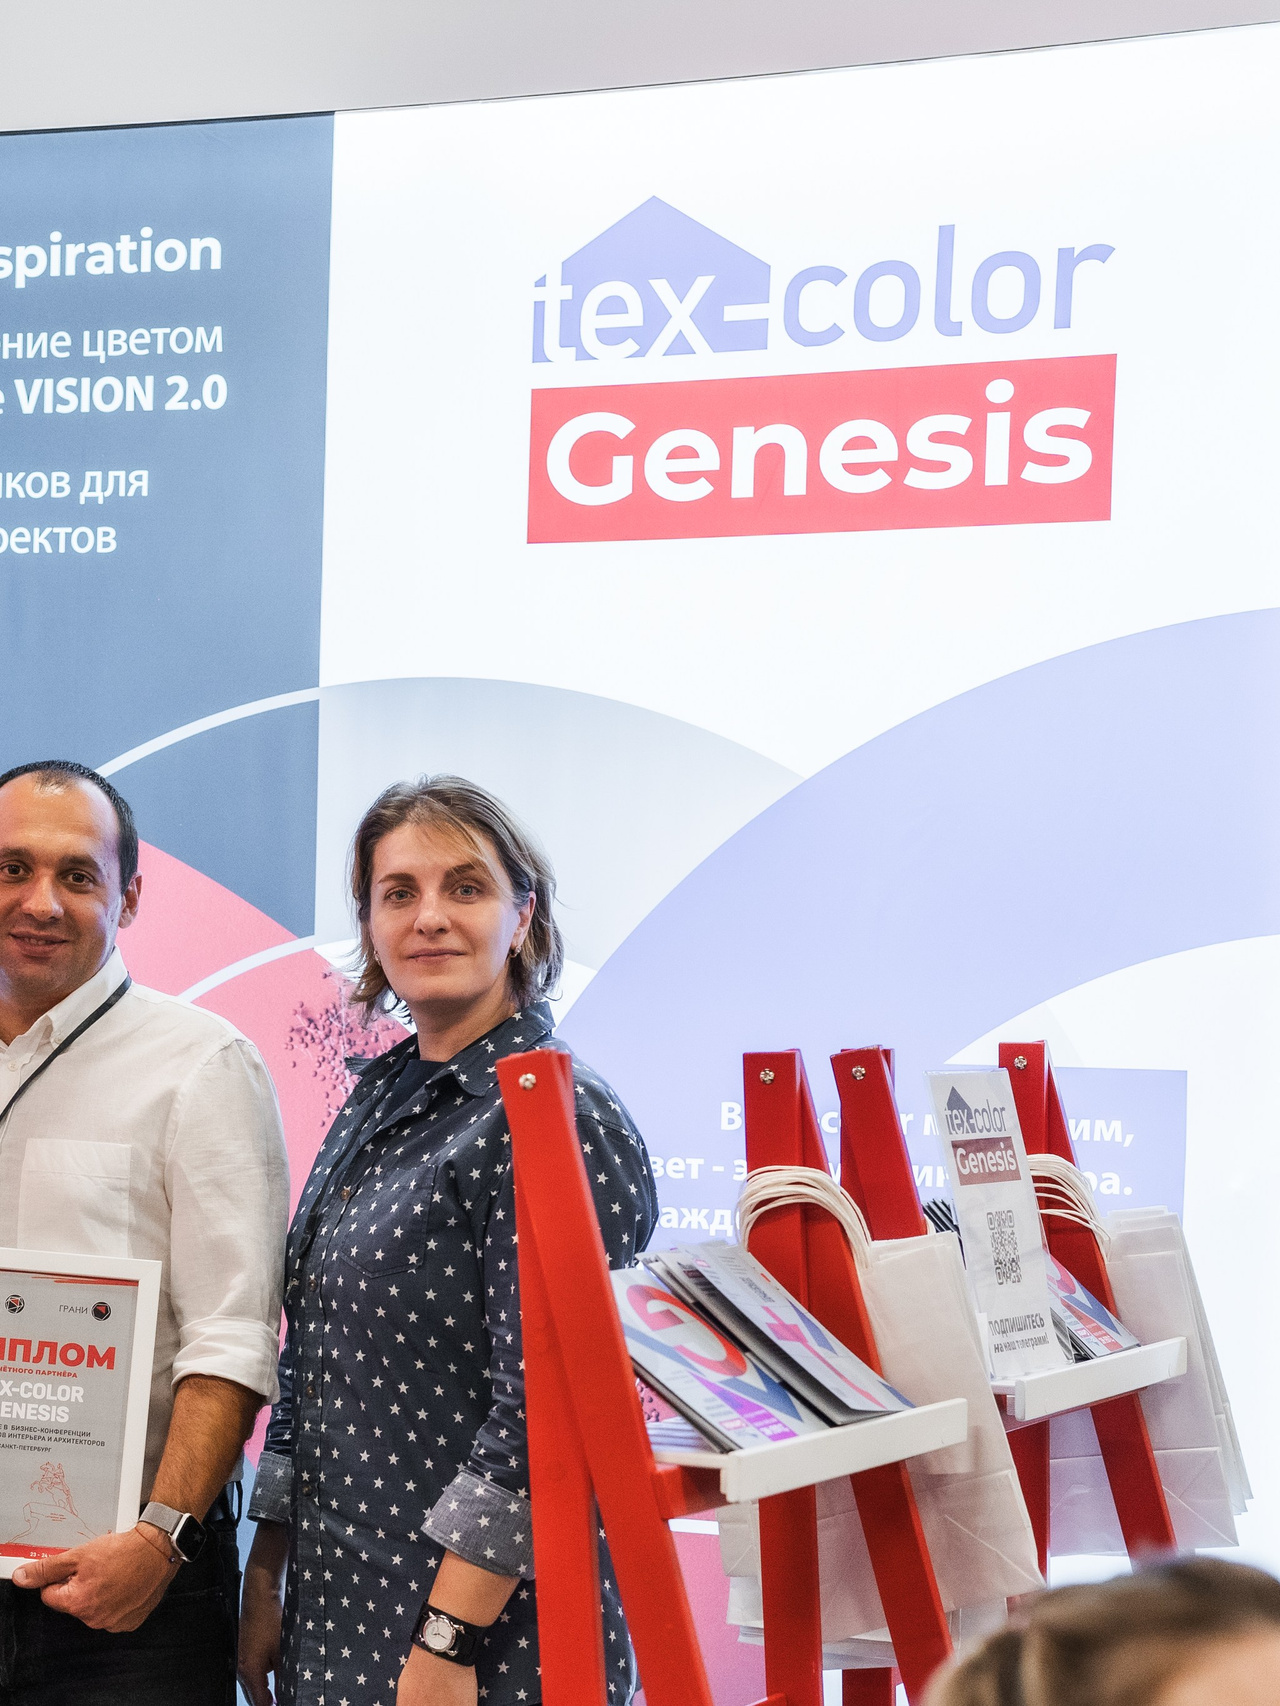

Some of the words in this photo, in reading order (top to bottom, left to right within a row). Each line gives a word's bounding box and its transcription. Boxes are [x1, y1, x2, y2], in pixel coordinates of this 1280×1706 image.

[532, 223, 1116, 362] tex-color
[83, 325, 223, 363] цветом
[13, 375, 154, 415] VISION
[164, 374, 228, 411] 2.0
[545, 377, 1094, 507] Genesis
[79, 469, 149, 505] для
[945, 1099, 1007, 1135] tex-color
[649, 1156, 704, 1180] вет
[955, 1142, 1017, 1175] Genesis
[59, 1304, 88, 1315] ГРАНИ
[988, 1312, 1045, 1338] ПОДПИШИТЕСЬ
[35, 1368, 78, 1379] ПАРТНЁРА
[7, 1432, 46, 1442] ИНТЕРЬЕРА
[53, 1436, 106, 1447] АРХИТЕКТОРОВ
[11, 1425, 91, 1438] БИЗНЕС-КОНФЕРЕНЦИИ
